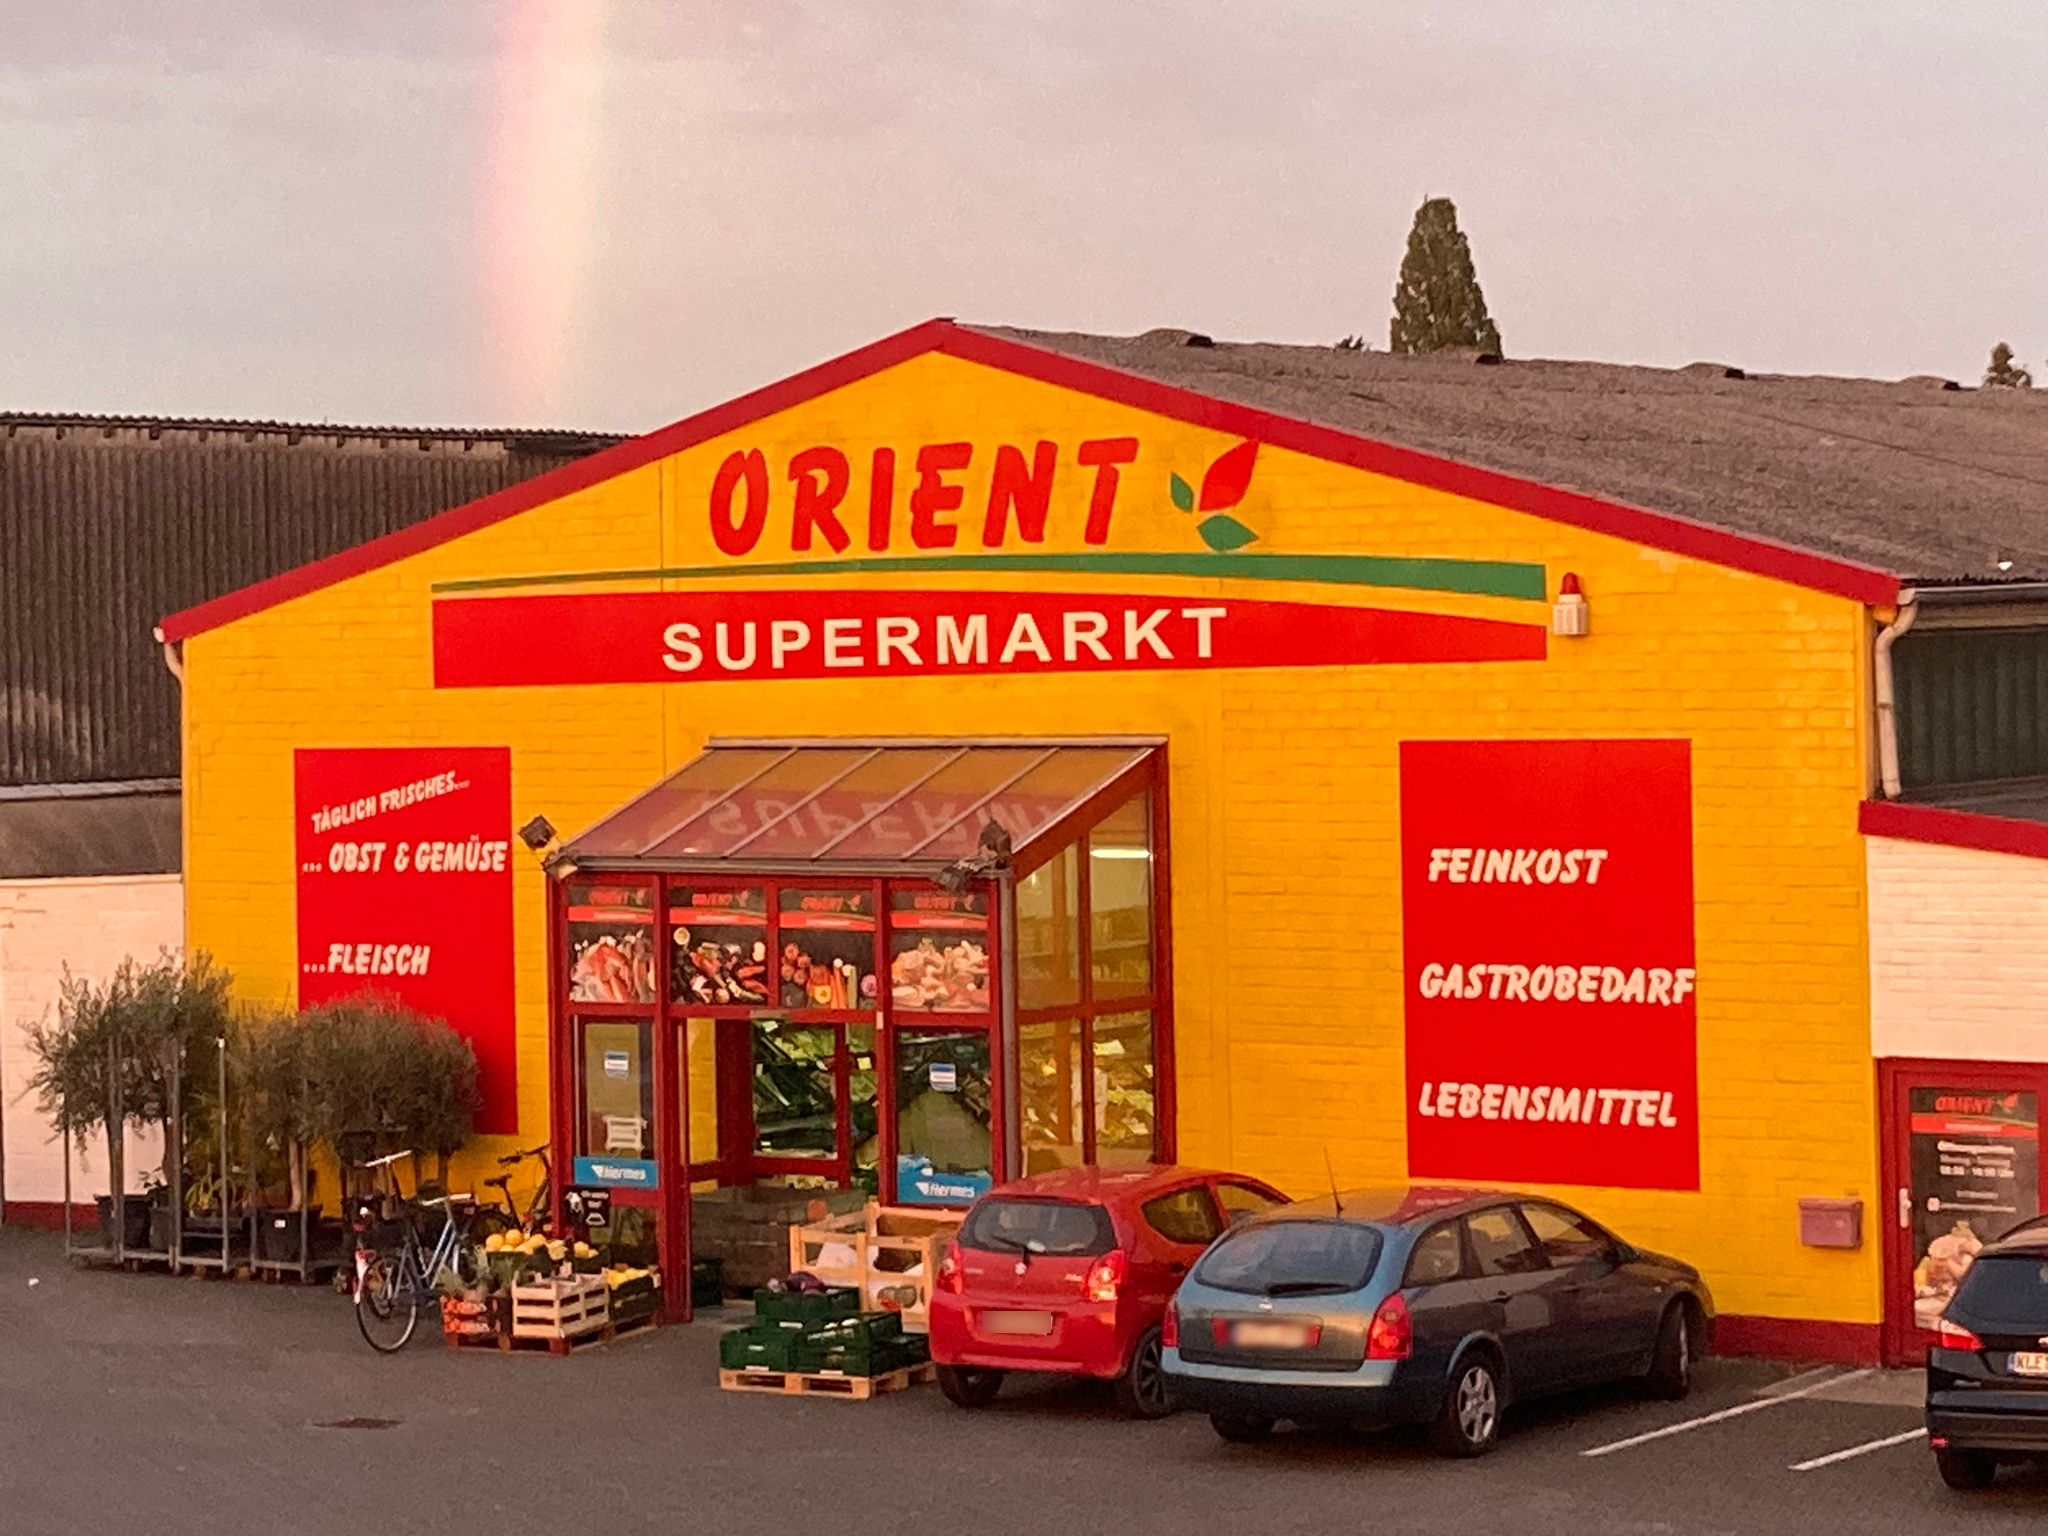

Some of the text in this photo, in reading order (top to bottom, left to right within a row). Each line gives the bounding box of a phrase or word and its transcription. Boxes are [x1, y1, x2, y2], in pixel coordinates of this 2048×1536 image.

[709, 437, 1139, 556] ORIENT
[661, 606, 1228, 672] SUPERMARKT
[311, 795, 377, 834] TÄGLICH
[328, 842, 387, 873] OBST
[393, 842, 410, 873] &
[415, 834, 508, 873] GEMÜSE
[1428, 848, 1608, 885] FEINKOST
[1419, 963, 1696, 1006] GASTROBEDARF
[1418, 1082, 1677, 1127] LEBENSMITTEL
